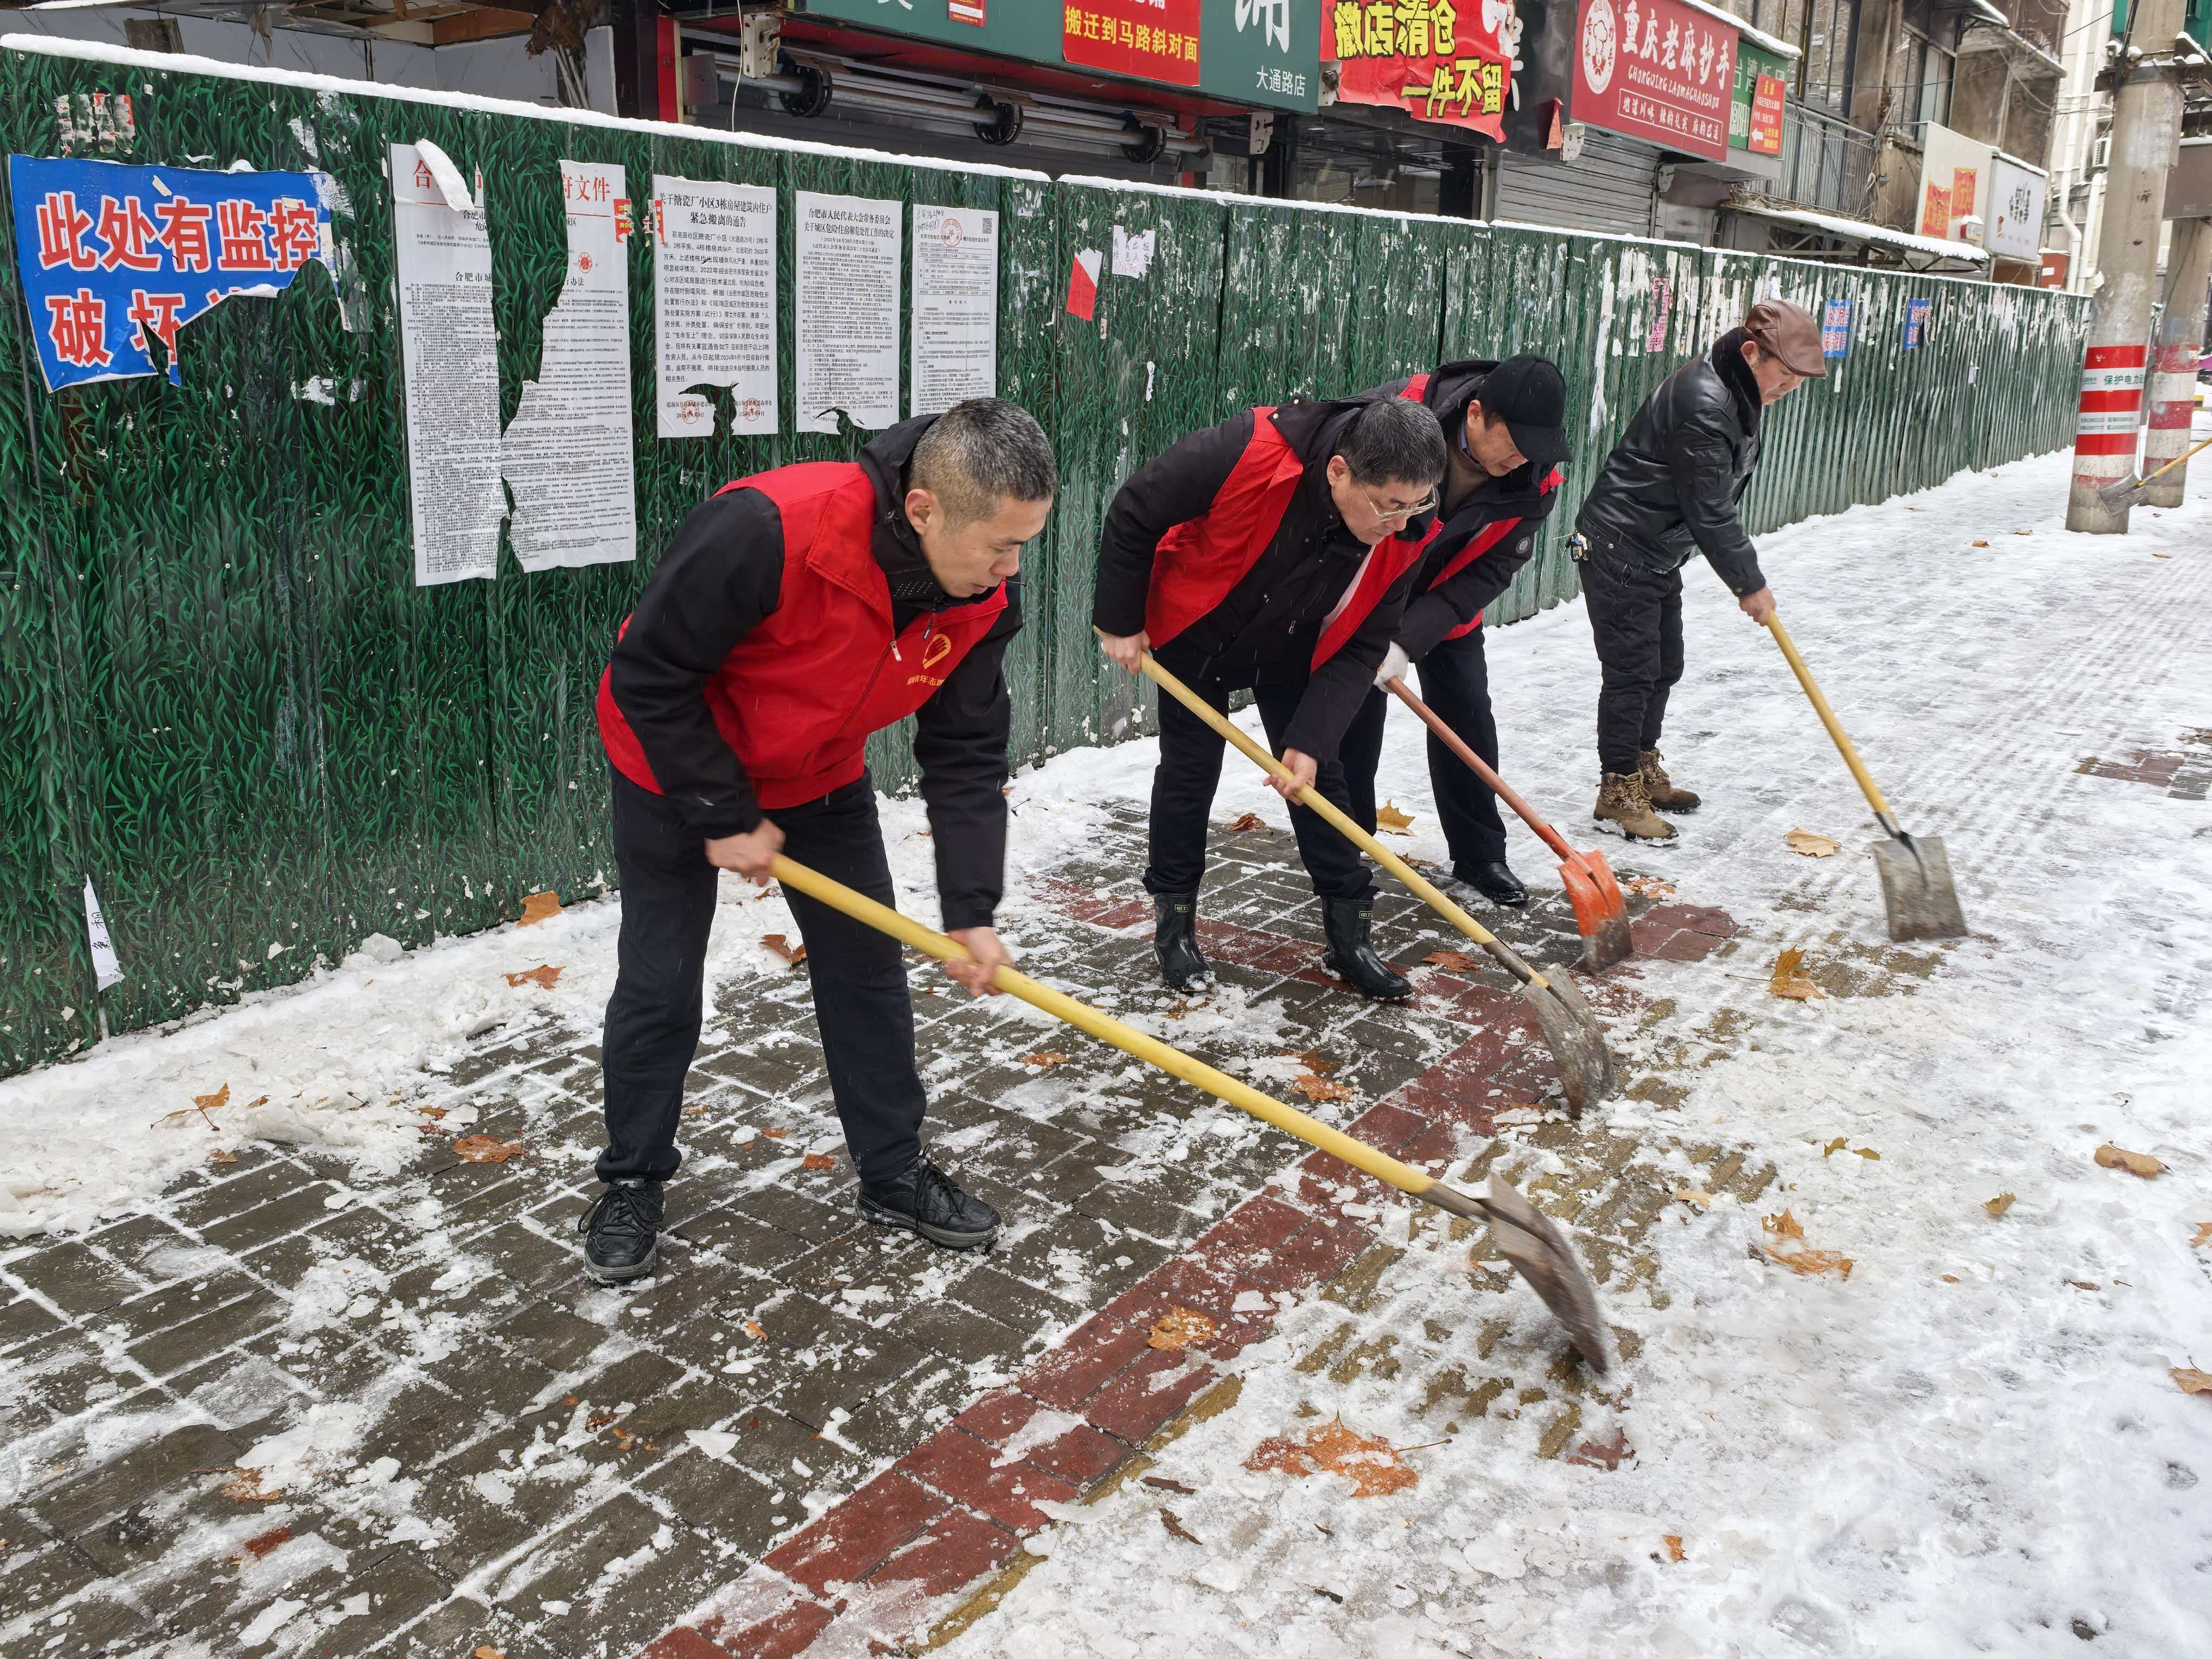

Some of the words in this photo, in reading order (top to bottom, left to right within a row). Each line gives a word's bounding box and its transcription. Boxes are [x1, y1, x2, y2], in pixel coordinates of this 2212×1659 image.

[1065, 5, 1198, 63] 搬迁到马路斜对面
[1334, 0, 1456, 58] 撤店清仓
[1622, 0, 1730, 90] 重庆老麻抄手
[1256, 64, 1306, 98] 大通路店
[1401, 58, 1502, 118] 一件不留
[1628, 64, 1668, 92] CHONGQING
[36, 191, 320, 272] 此处有监控
[690, 211, 747, 228] 紧急搬离的通告
